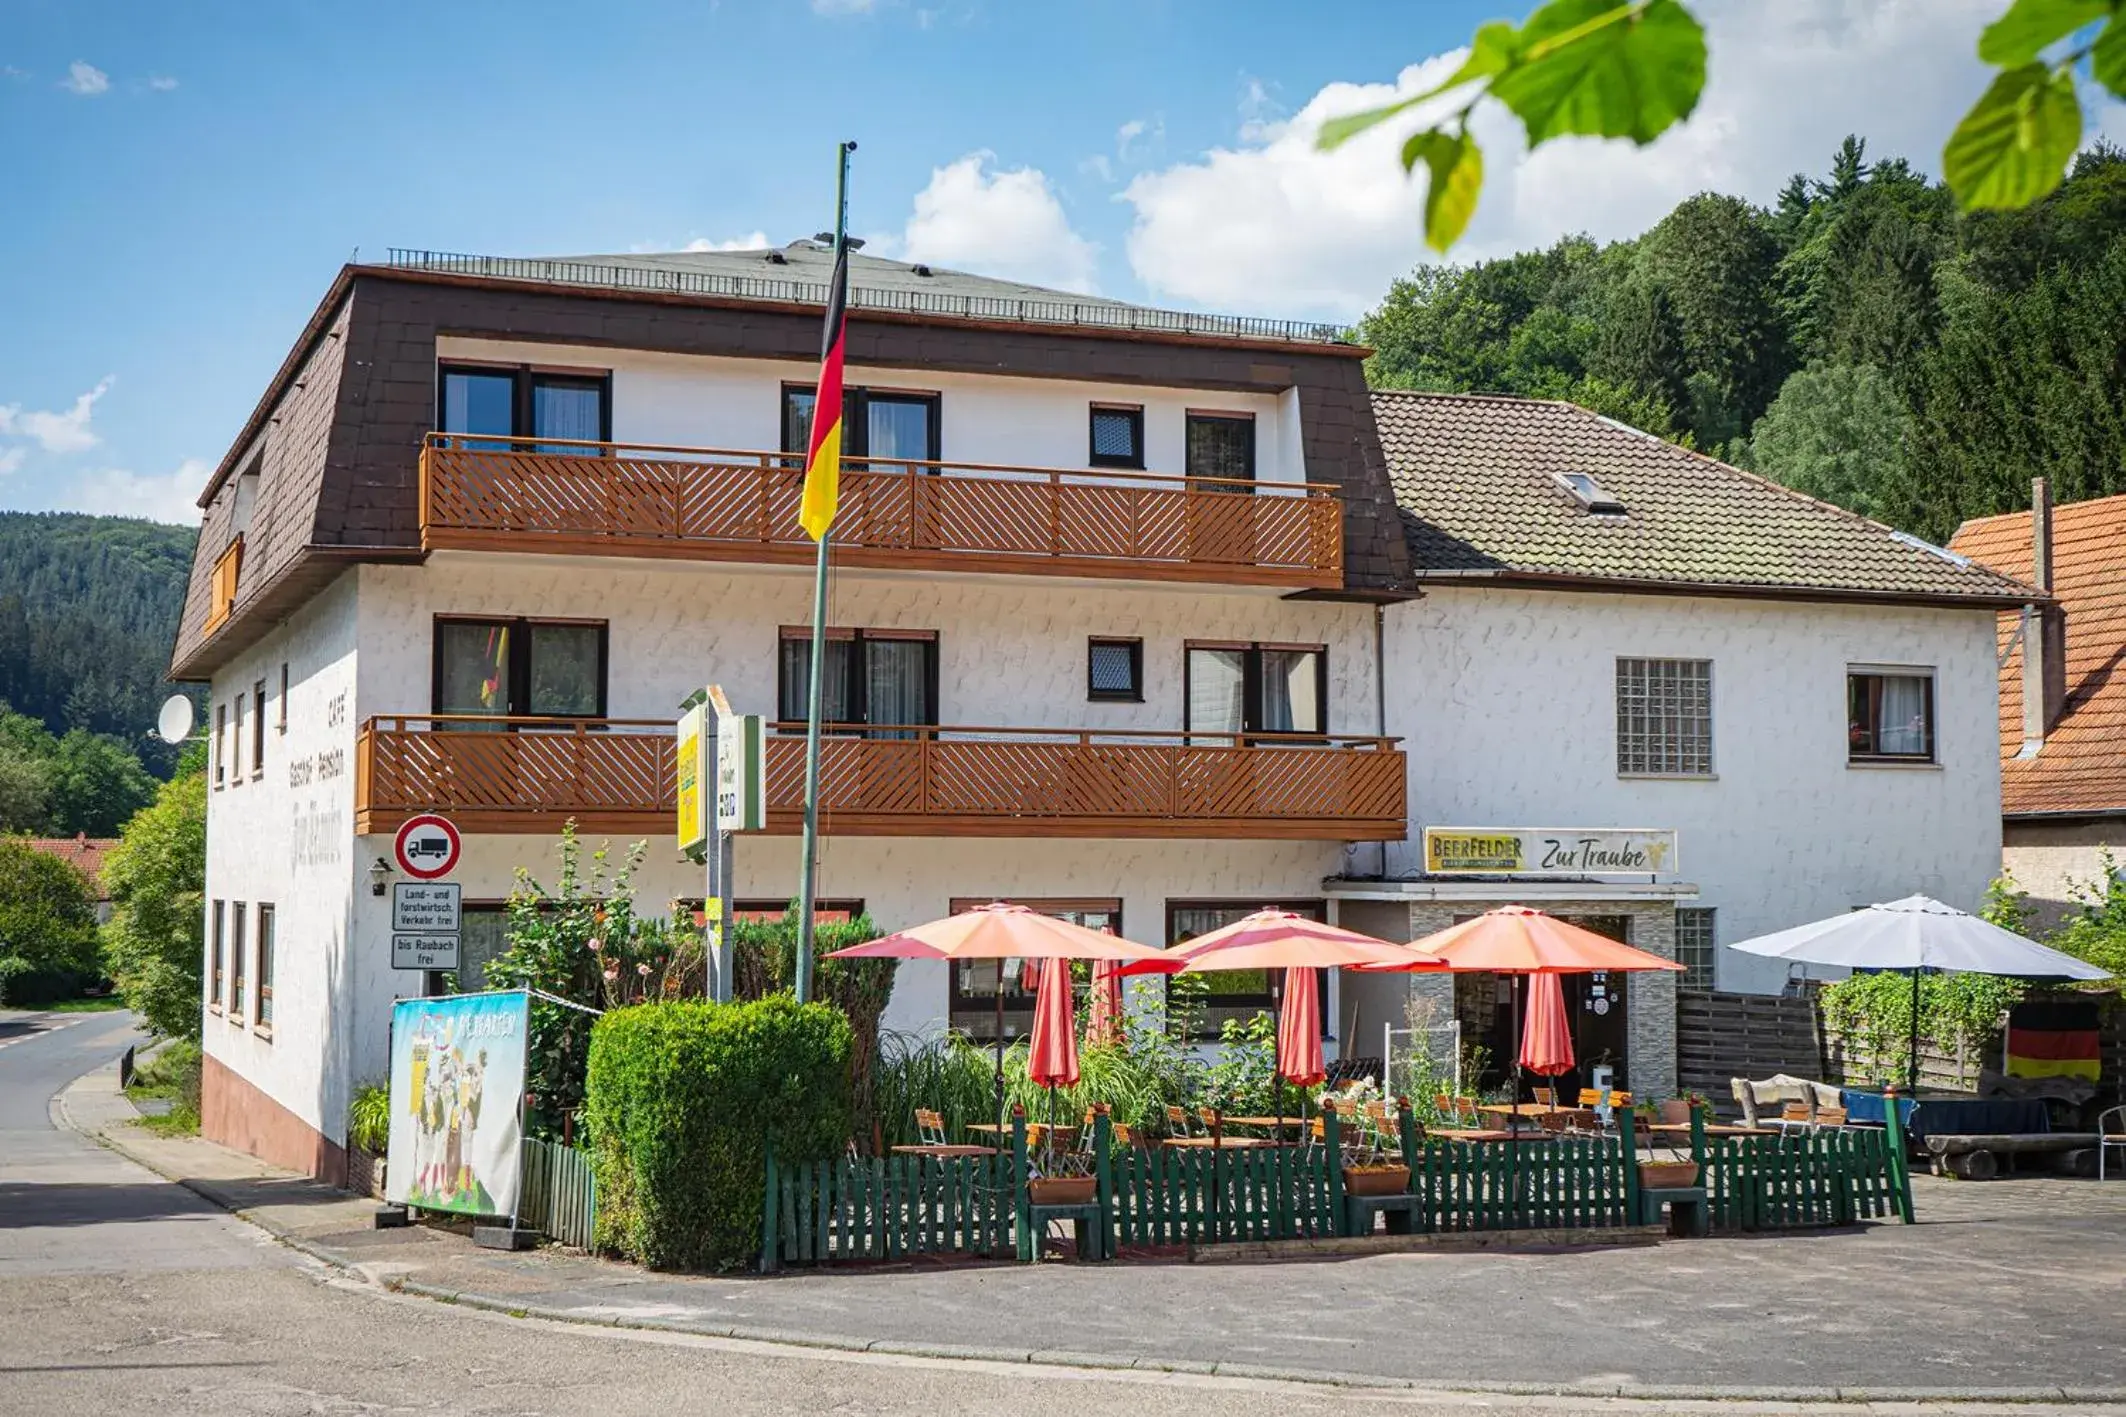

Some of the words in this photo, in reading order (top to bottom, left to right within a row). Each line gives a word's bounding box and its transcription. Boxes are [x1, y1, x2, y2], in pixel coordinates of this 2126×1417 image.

[1433, 836, 1523, 858] BEERFELDER
[1542, 839, 1575, 869] Zur
[1578, 838, 1646, 869] Traube
[405, 889, 430, 899] Land-
[434, 889, 450, 900] und
[401, 902, 454, 912] forstwirtsch.
[401, 915, 433, 925] Verkehr
[438, 916, 453, 925] frei
[398, 939, 412, 950] bis
[416, 940, 455, 950] Raubach
[418, 953, 434, 964] frei
